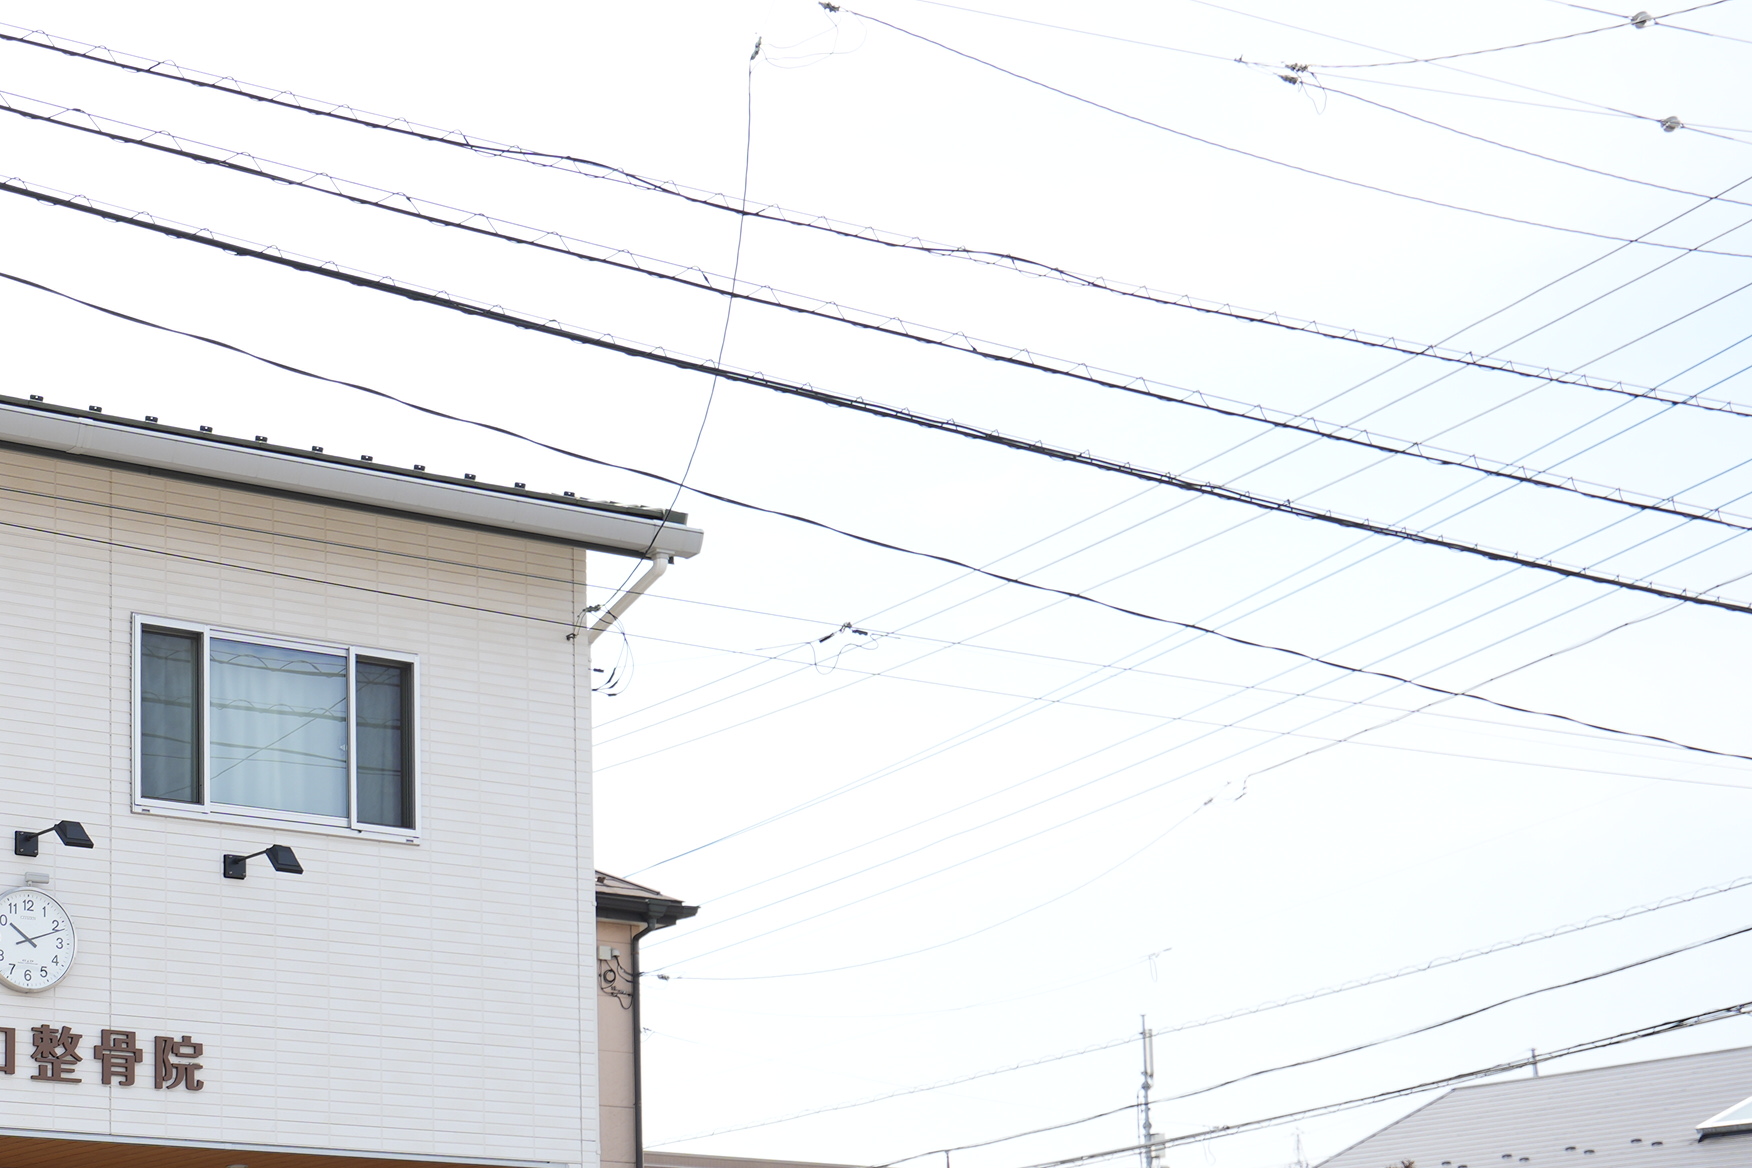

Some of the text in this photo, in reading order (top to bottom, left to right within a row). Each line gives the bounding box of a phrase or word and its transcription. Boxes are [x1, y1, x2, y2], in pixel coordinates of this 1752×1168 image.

[8, 902, 17, 914] 11
[22, 899, 34, 911] 12
[51, 919, 59, 931] 2
[55, 937, 64, 949] 3
[51, 954, 59, 966] 4
[8, 963, 16, 975] 7
[24, 969, 32, 981] 6
[39, 966, 48, 978] 5
